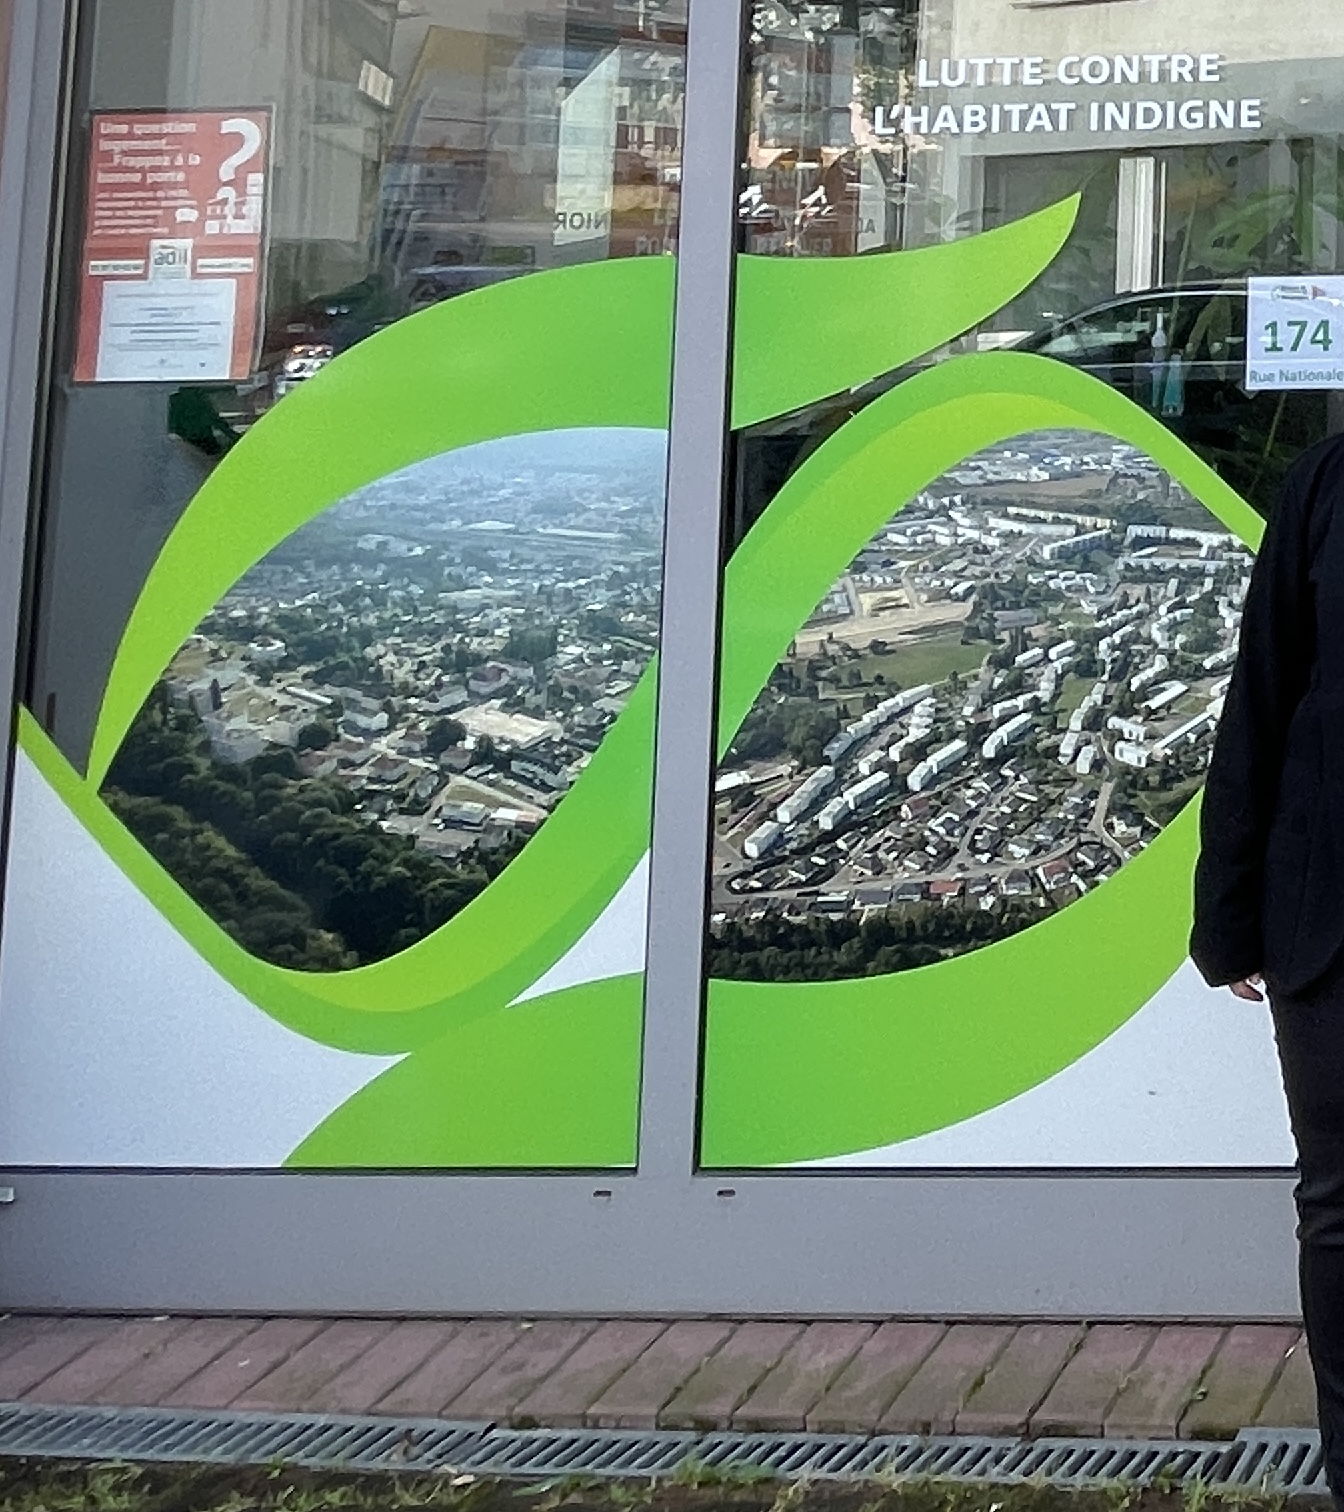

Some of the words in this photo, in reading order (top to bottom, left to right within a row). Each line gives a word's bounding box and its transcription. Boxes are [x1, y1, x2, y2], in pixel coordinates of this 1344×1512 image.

[918, 55, 1045, 88] LUTTE
[1056, 53, 1221, 85] CONTRE
[873, 101, 1076, 136] L'HABITAT
[1089, 98, 1262, 132] INDIGNE
[1264, 319, 1333, 353] 174
[1249, 370, 1276, 383] Rue
[1279, 368, 1344, 383] Nationale
